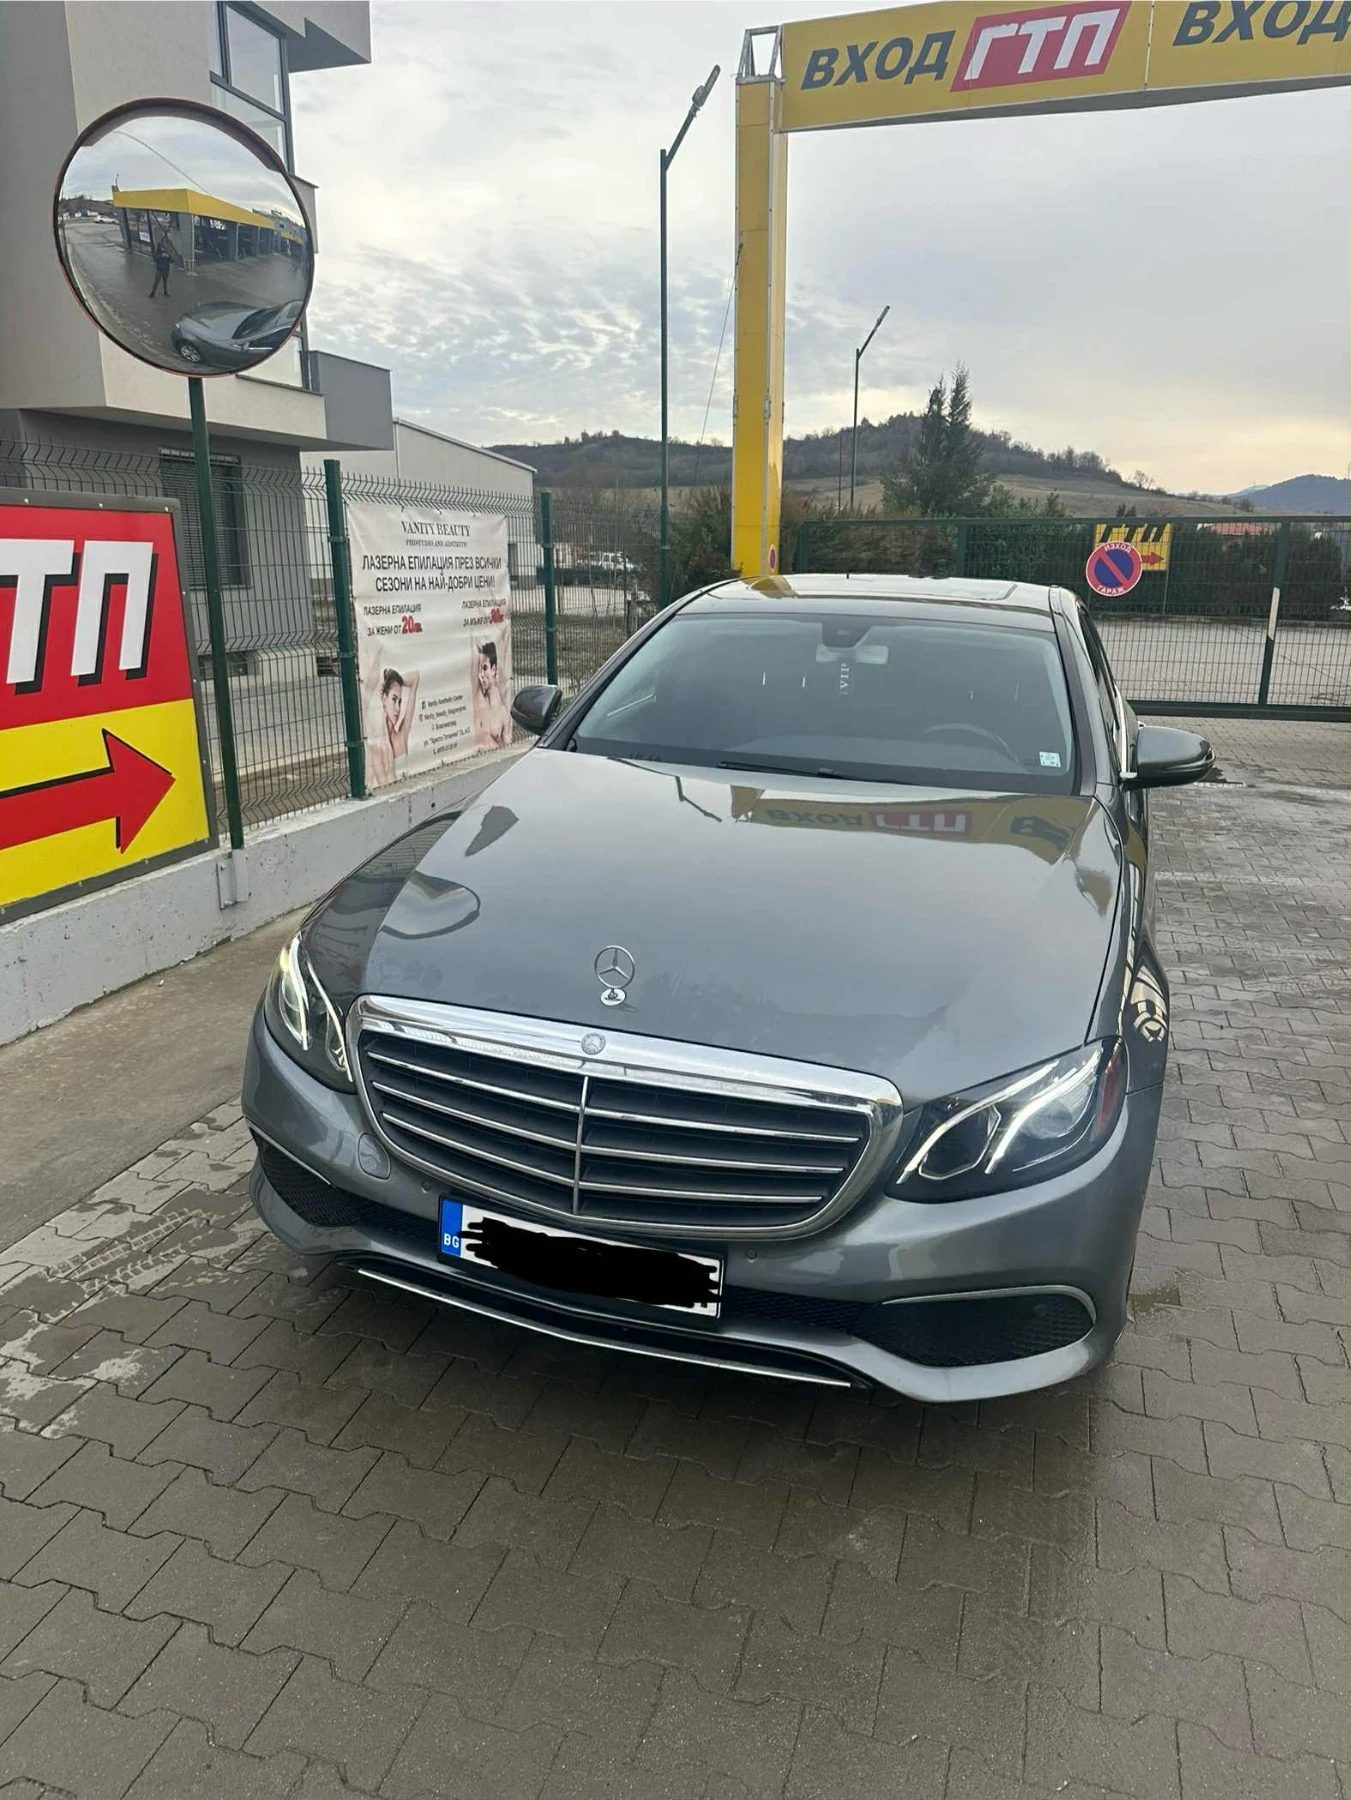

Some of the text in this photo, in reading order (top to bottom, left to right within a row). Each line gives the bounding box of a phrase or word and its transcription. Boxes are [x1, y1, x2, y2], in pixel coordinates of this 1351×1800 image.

[1172, 0, 1351, 46] ВХОД
[801, 8, 1120, 90] ВХОД ГТП
[401, 521, 470, 537] VANITY BEAUTY
[1104, 543, 1132, 554] ИЗХОД
[362, 555, 502, 572] ЛАЗЕРНА ЕПИЛАЦИЯ ПРЕЗ ВСИЧКИ
[375, 577, 412, 592] СЕЗОНИ
[414, 577, 427, 591] НА
[429, 572, 473, 592] НАЙ-ДОБРИ
[1097, 585, 1124, 595] ГАРАЖ
[363, 604, 422, 616] ЛАЗЕРНА ЕПИЛАЦИЯ
[367, 629, 376, 637] ЗА
[376, 626, 393, 636] ЖЕНИ
[393, 625, 402, 635] ОТ
[443, 1233, 460, 1249] BG
